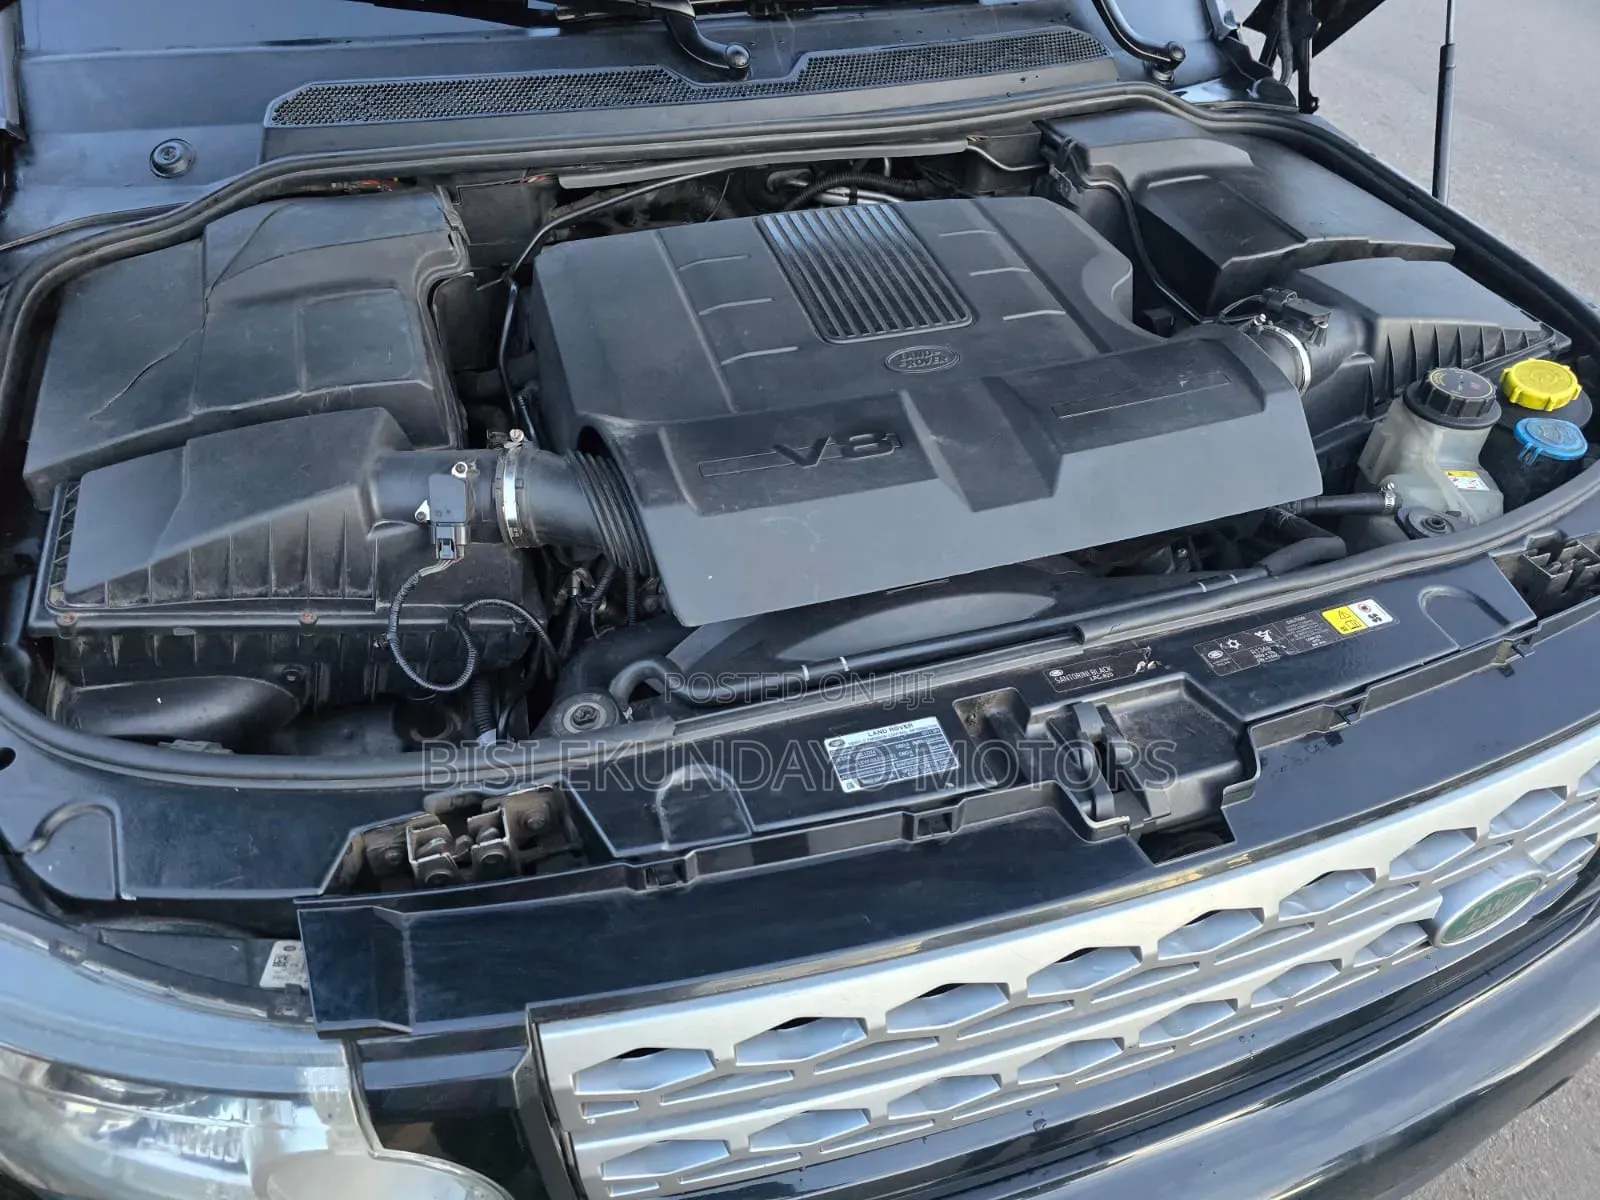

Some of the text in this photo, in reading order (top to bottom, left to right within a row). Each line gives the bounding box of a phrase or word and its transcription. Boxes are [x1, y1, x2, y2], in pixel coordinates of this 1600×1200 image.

[900, 355, 948, 368] ROVER
[773, 431, 897, 468] V8
[1054, 669, 1090, 684] SANTORINI
[1090, 664, 1113, 676] BLACK
[867, 722, 914, 737] LAND ROVER
